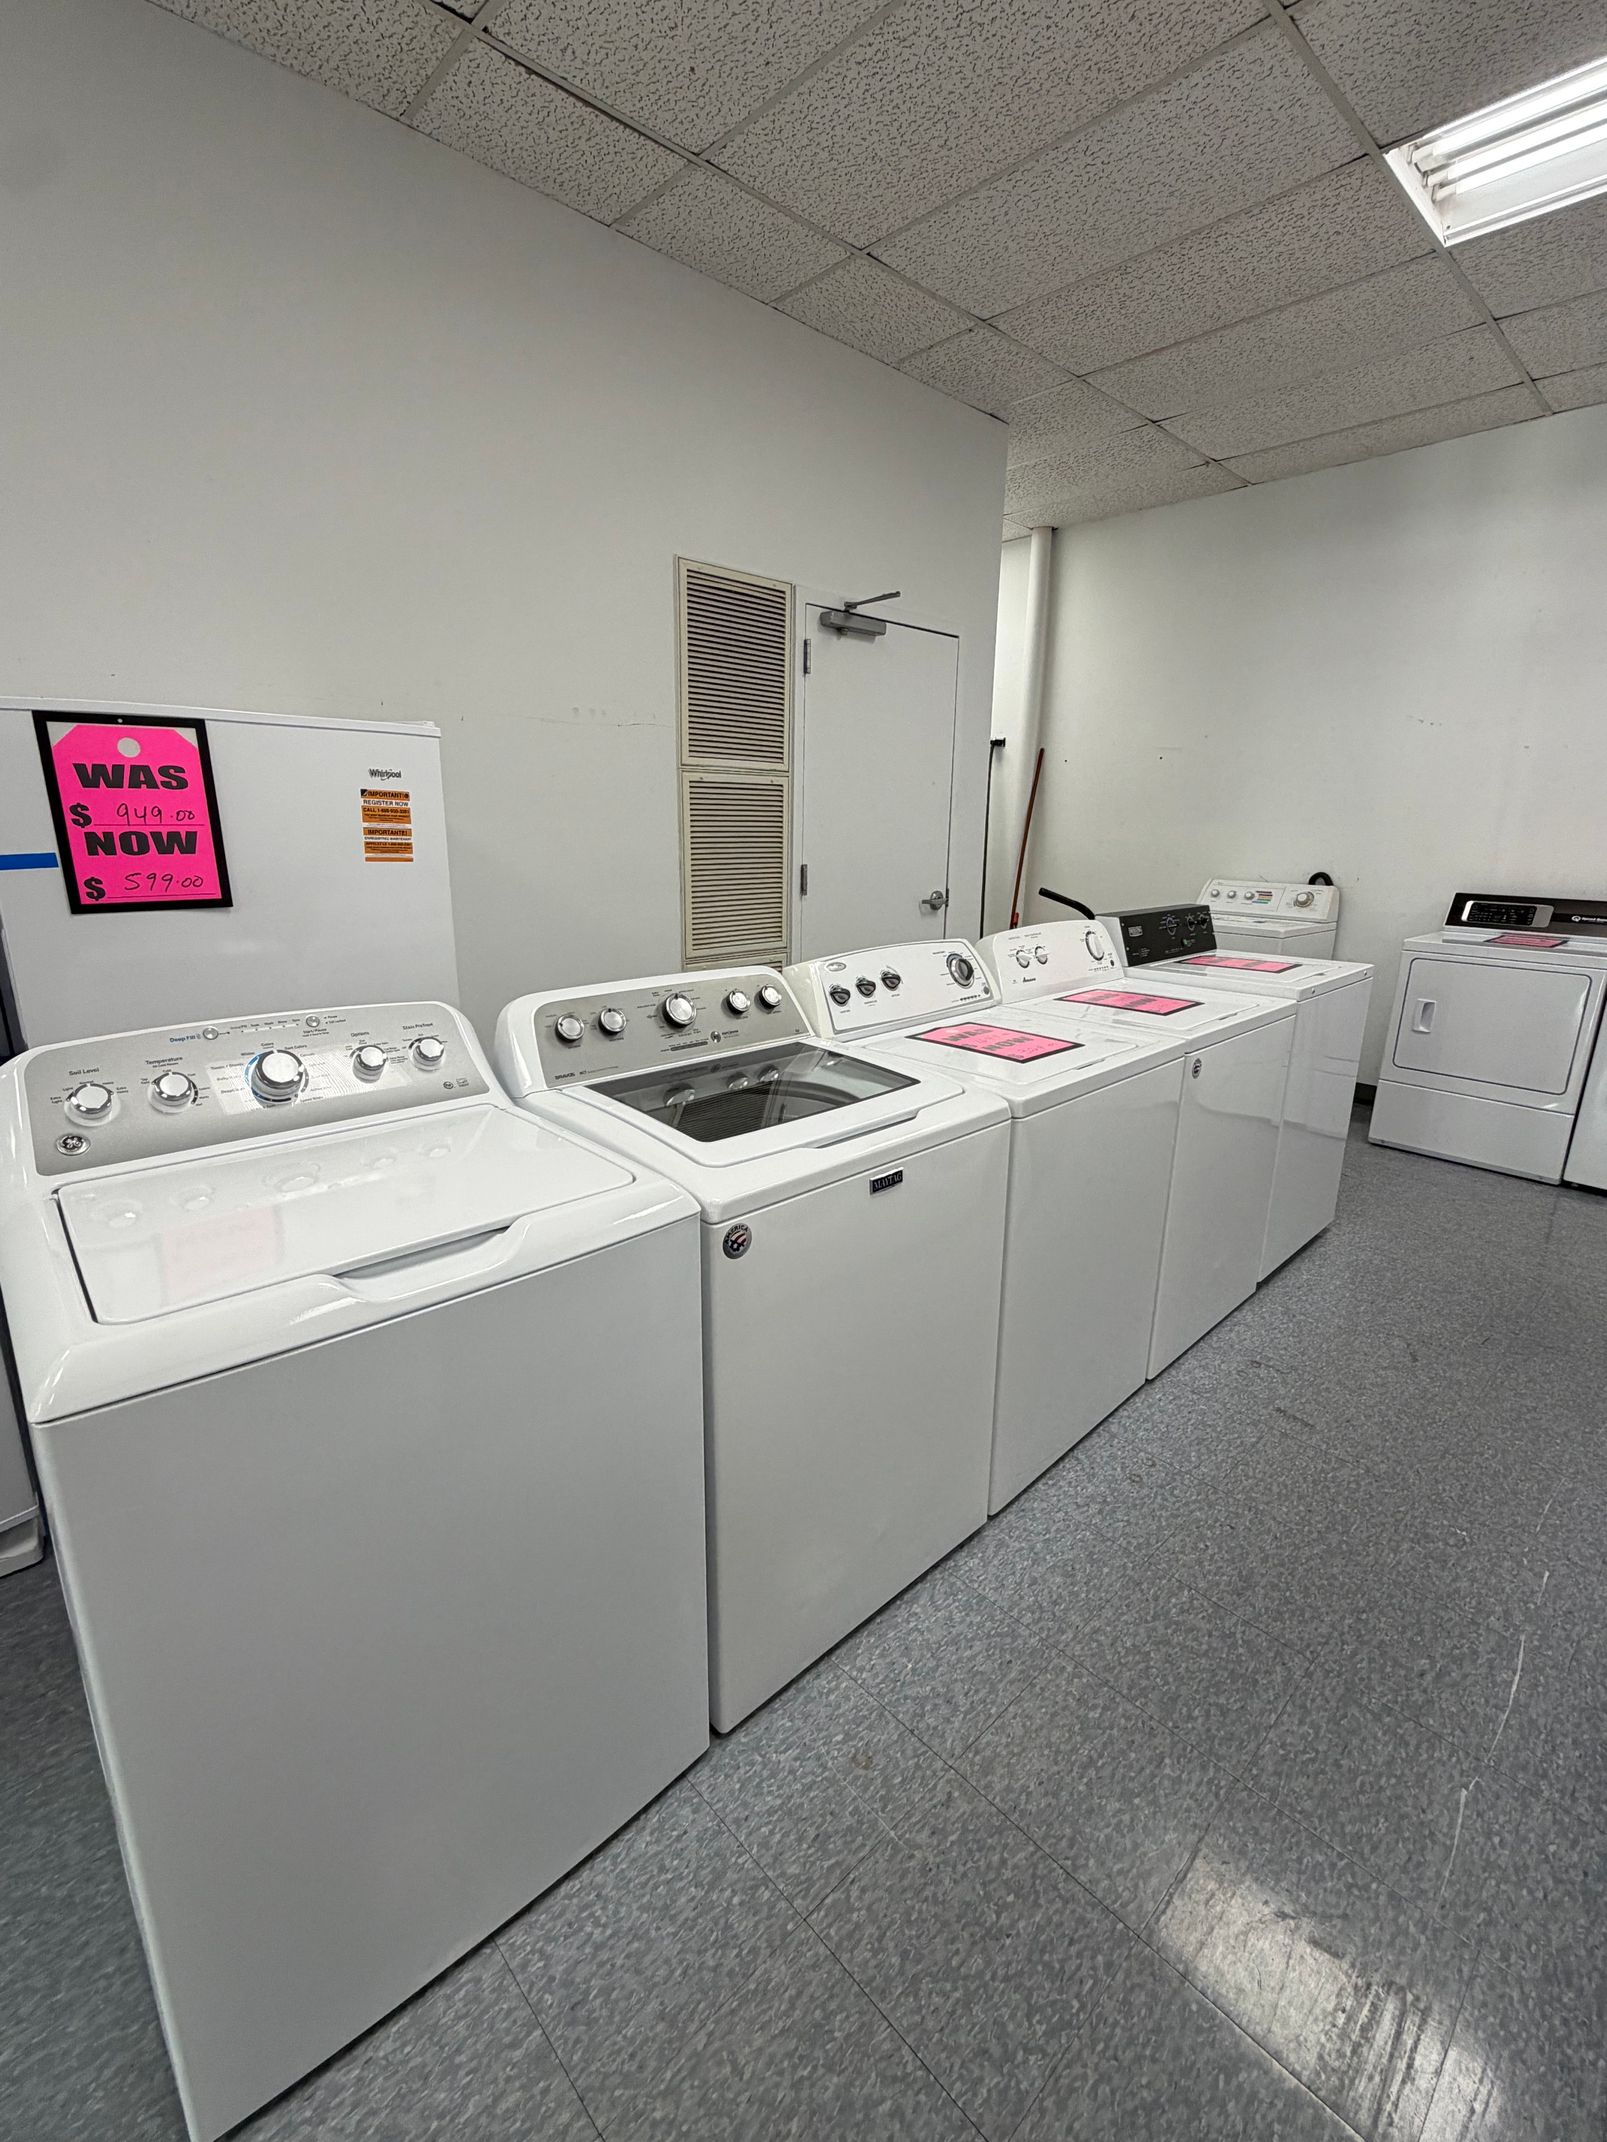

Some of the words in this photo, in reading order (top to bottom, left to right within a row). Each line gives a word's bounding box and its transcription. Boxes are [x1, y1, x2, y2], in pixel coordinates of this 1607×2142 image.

[73, 763, 190, 790] WAS
[368, 768, 402, 781] Whirlpool
[69, 803, 93, 828] $
[84, 831, 198, 857] NOW
[83, 877, 106, 902] $
[123, 872, 205, 892] 599.00
[145, 1056, 183, 1065] Temperature
[873, 1172, 903, 1192] MAYTAG
